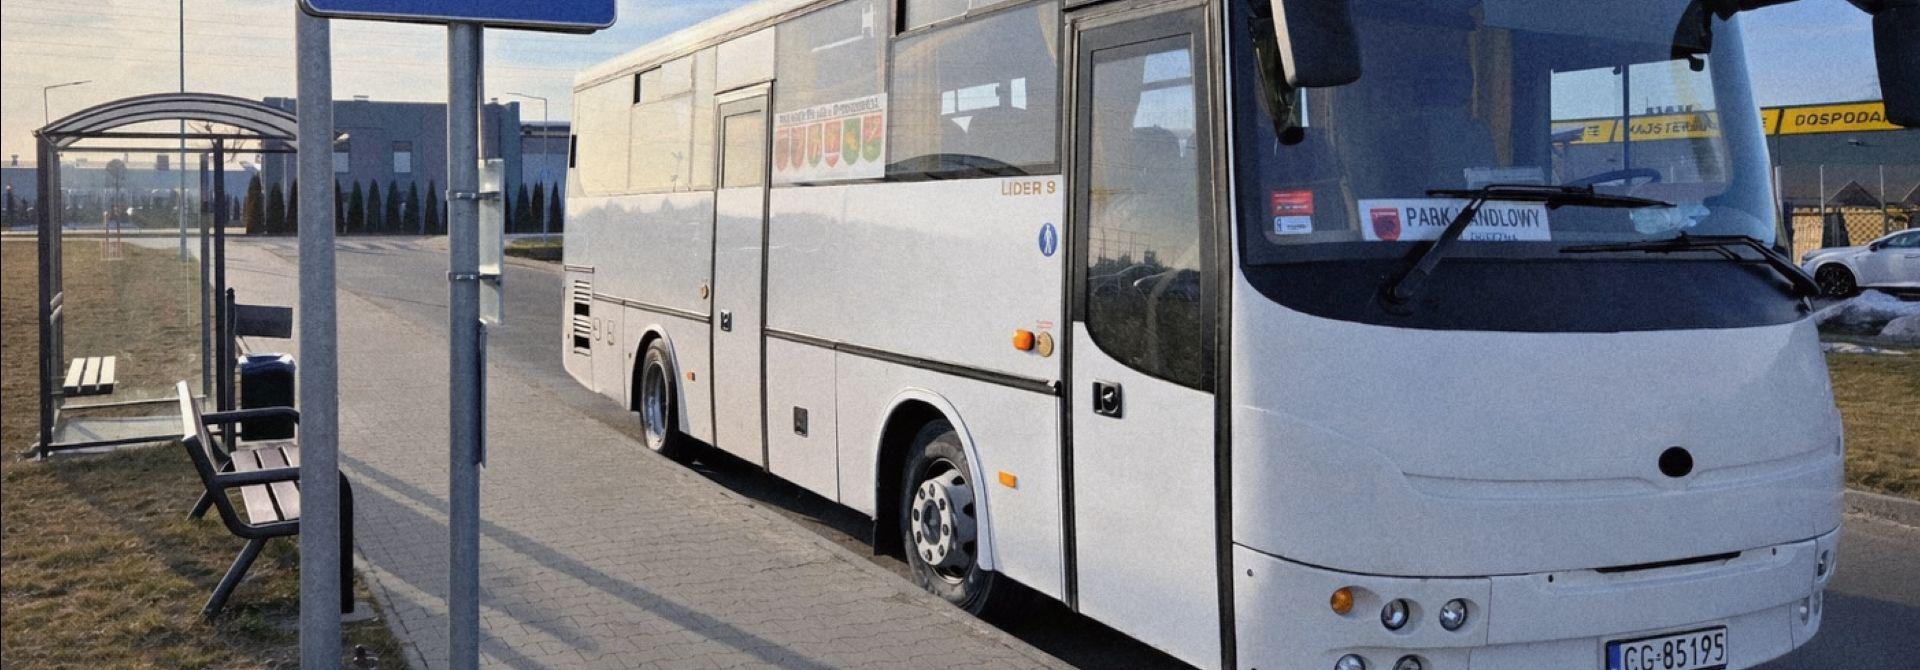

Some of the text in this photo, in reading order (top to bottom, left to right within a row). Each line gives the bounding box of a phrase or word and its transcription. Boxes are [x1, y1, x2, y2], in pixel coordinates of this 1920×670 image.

[1001, 181, 1042, 196] LIDER
[1406, 207, 1540, 228] PARK ANDLOWY
[1663, 633, 1724, 669] 85195
